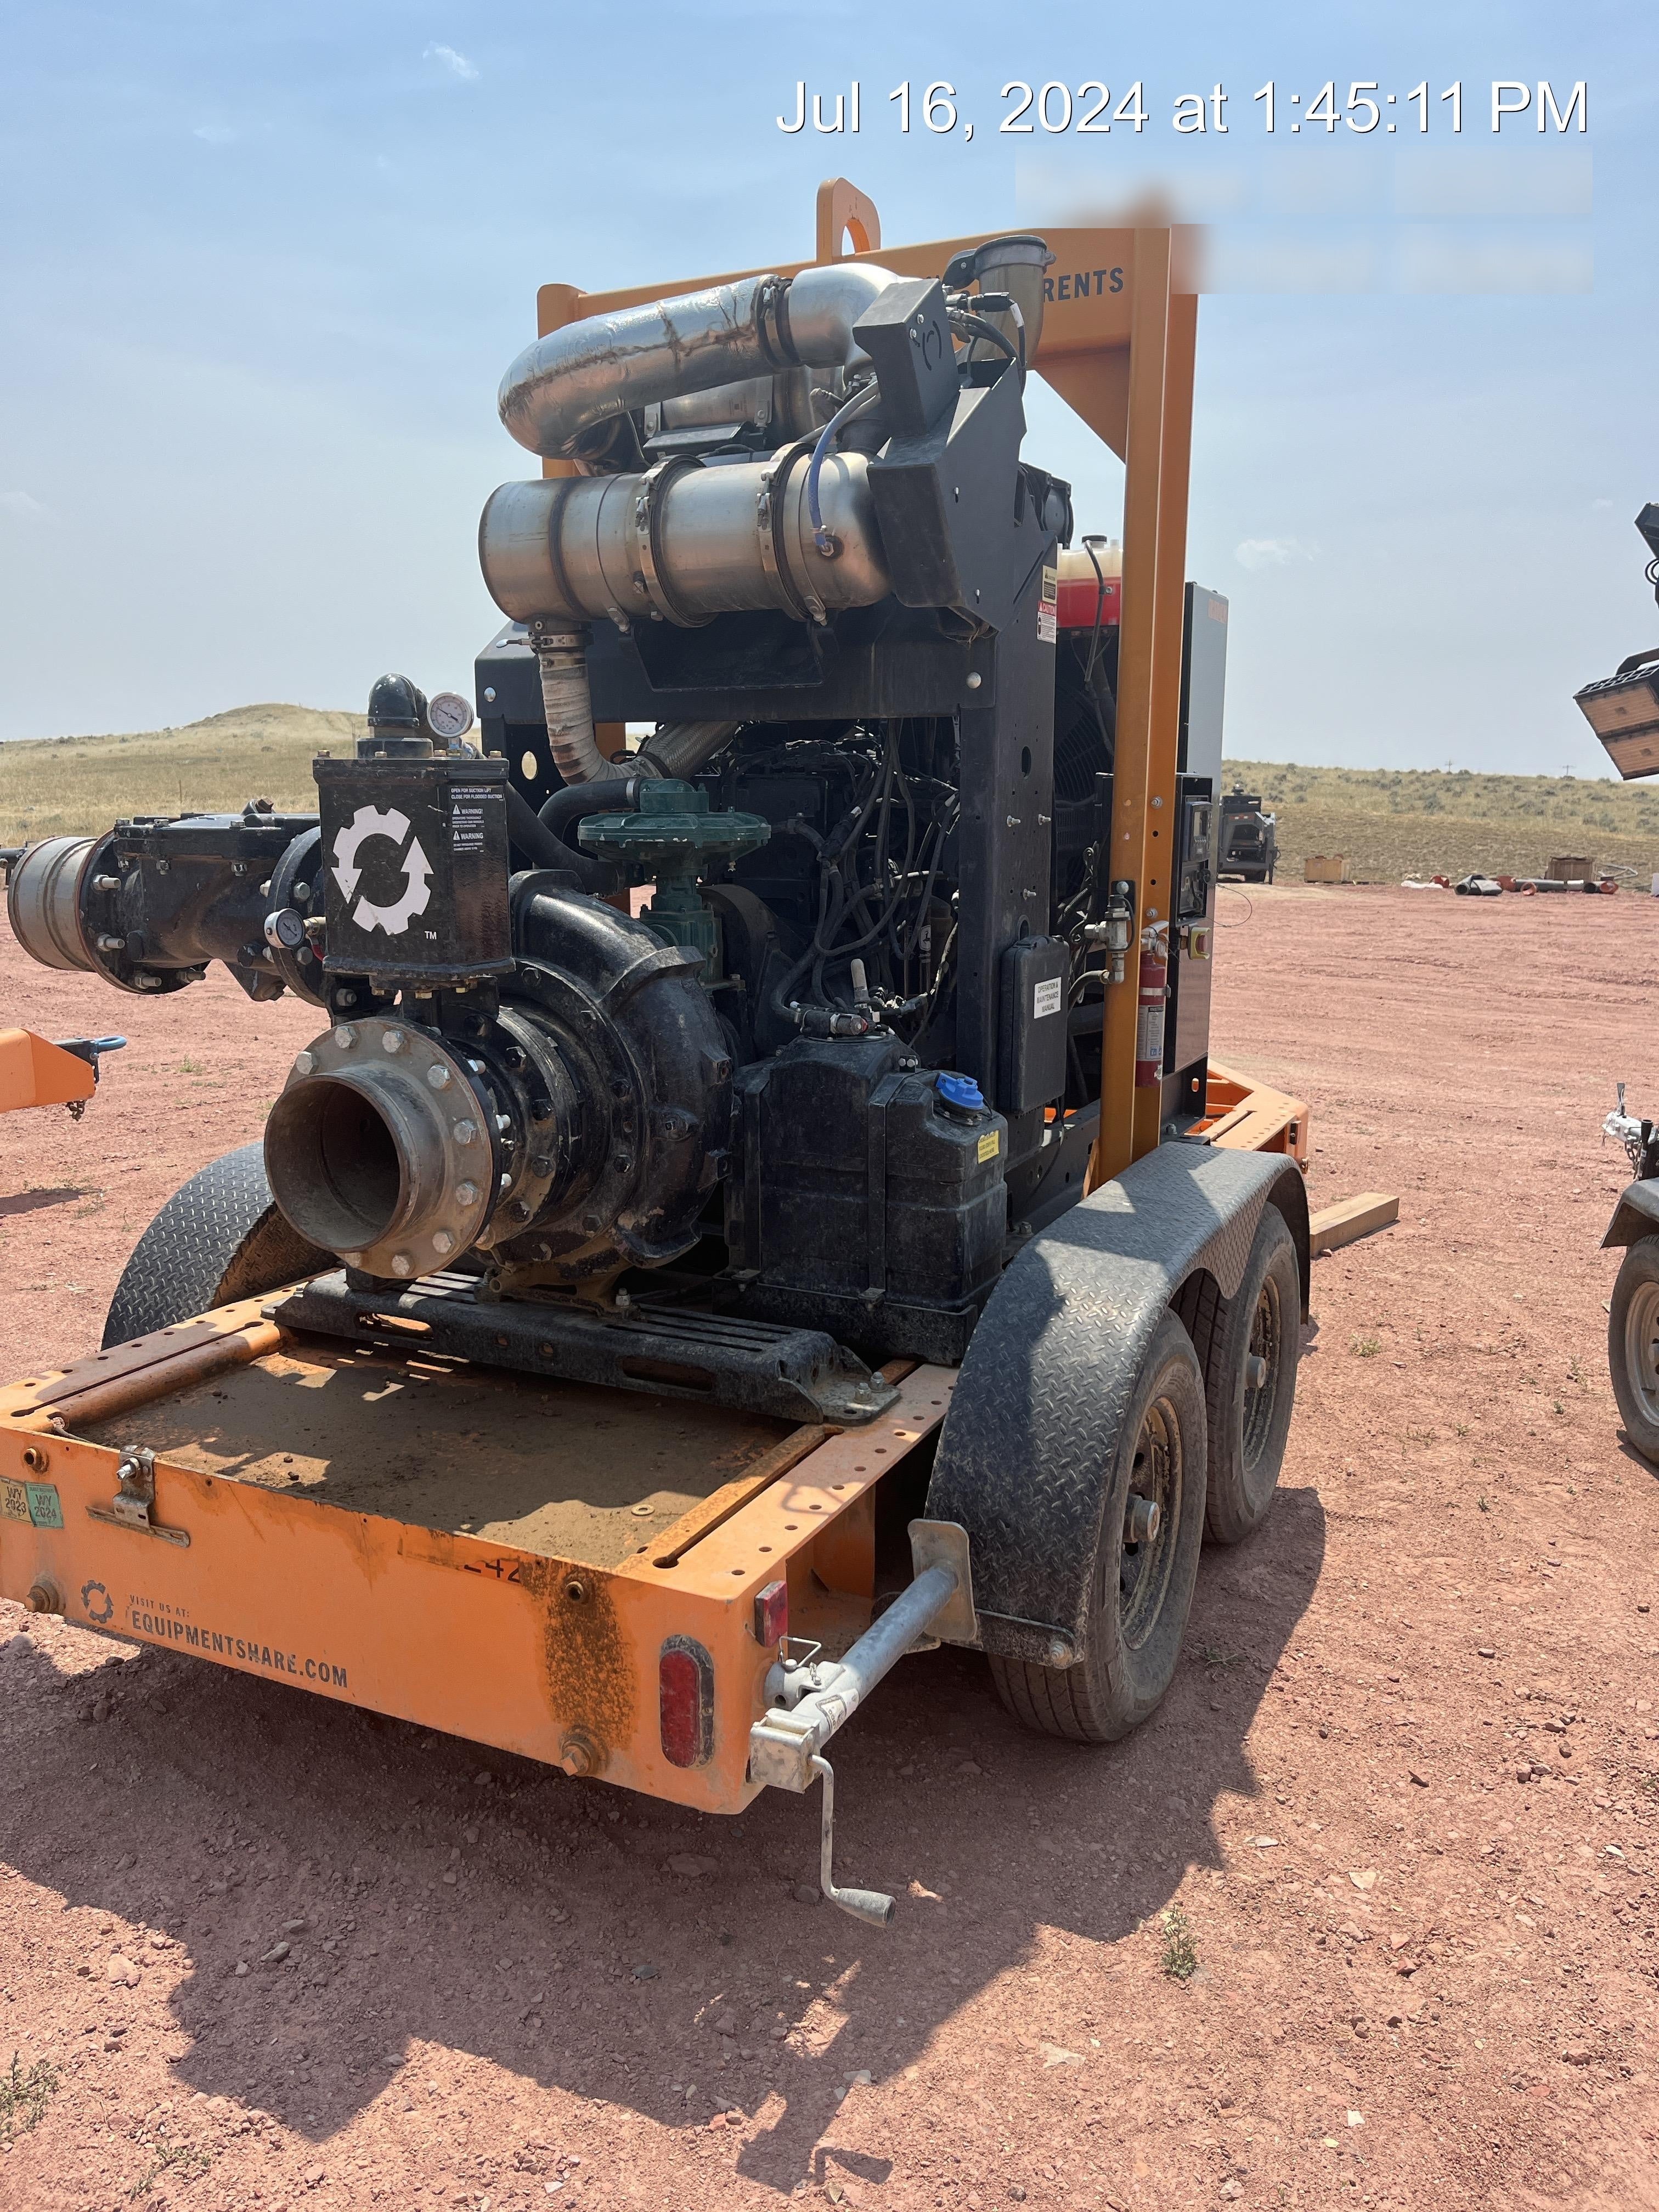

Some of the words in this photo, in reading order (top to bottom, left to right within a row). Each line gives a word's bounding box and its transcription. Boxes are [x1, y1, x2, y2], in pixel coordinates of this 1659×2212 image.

[1043, 267, 1124, 302] RENTS
[424, 930, 437, 940] TM
[1038, 983, 1056, 993] OPERATION
[1037, 991, 1059, 1003] MAINTENANCE
[1042, 1003, 1054, 1013] MANUAL
[7, 1486, 22, 1500] WY
[5, 1498, 26, 1513] 2023
[35, 1494, 52, 1506] WY
[34, 1506, 57, 1519] 2024
[129, 1594, 154, 1609] VISIT
[159, 1602, 171, 1613] US
[176, 1607, 189, 1618] AT:
[132, 1610, 347, 1689] EQUIPMENTSHARE.COM
